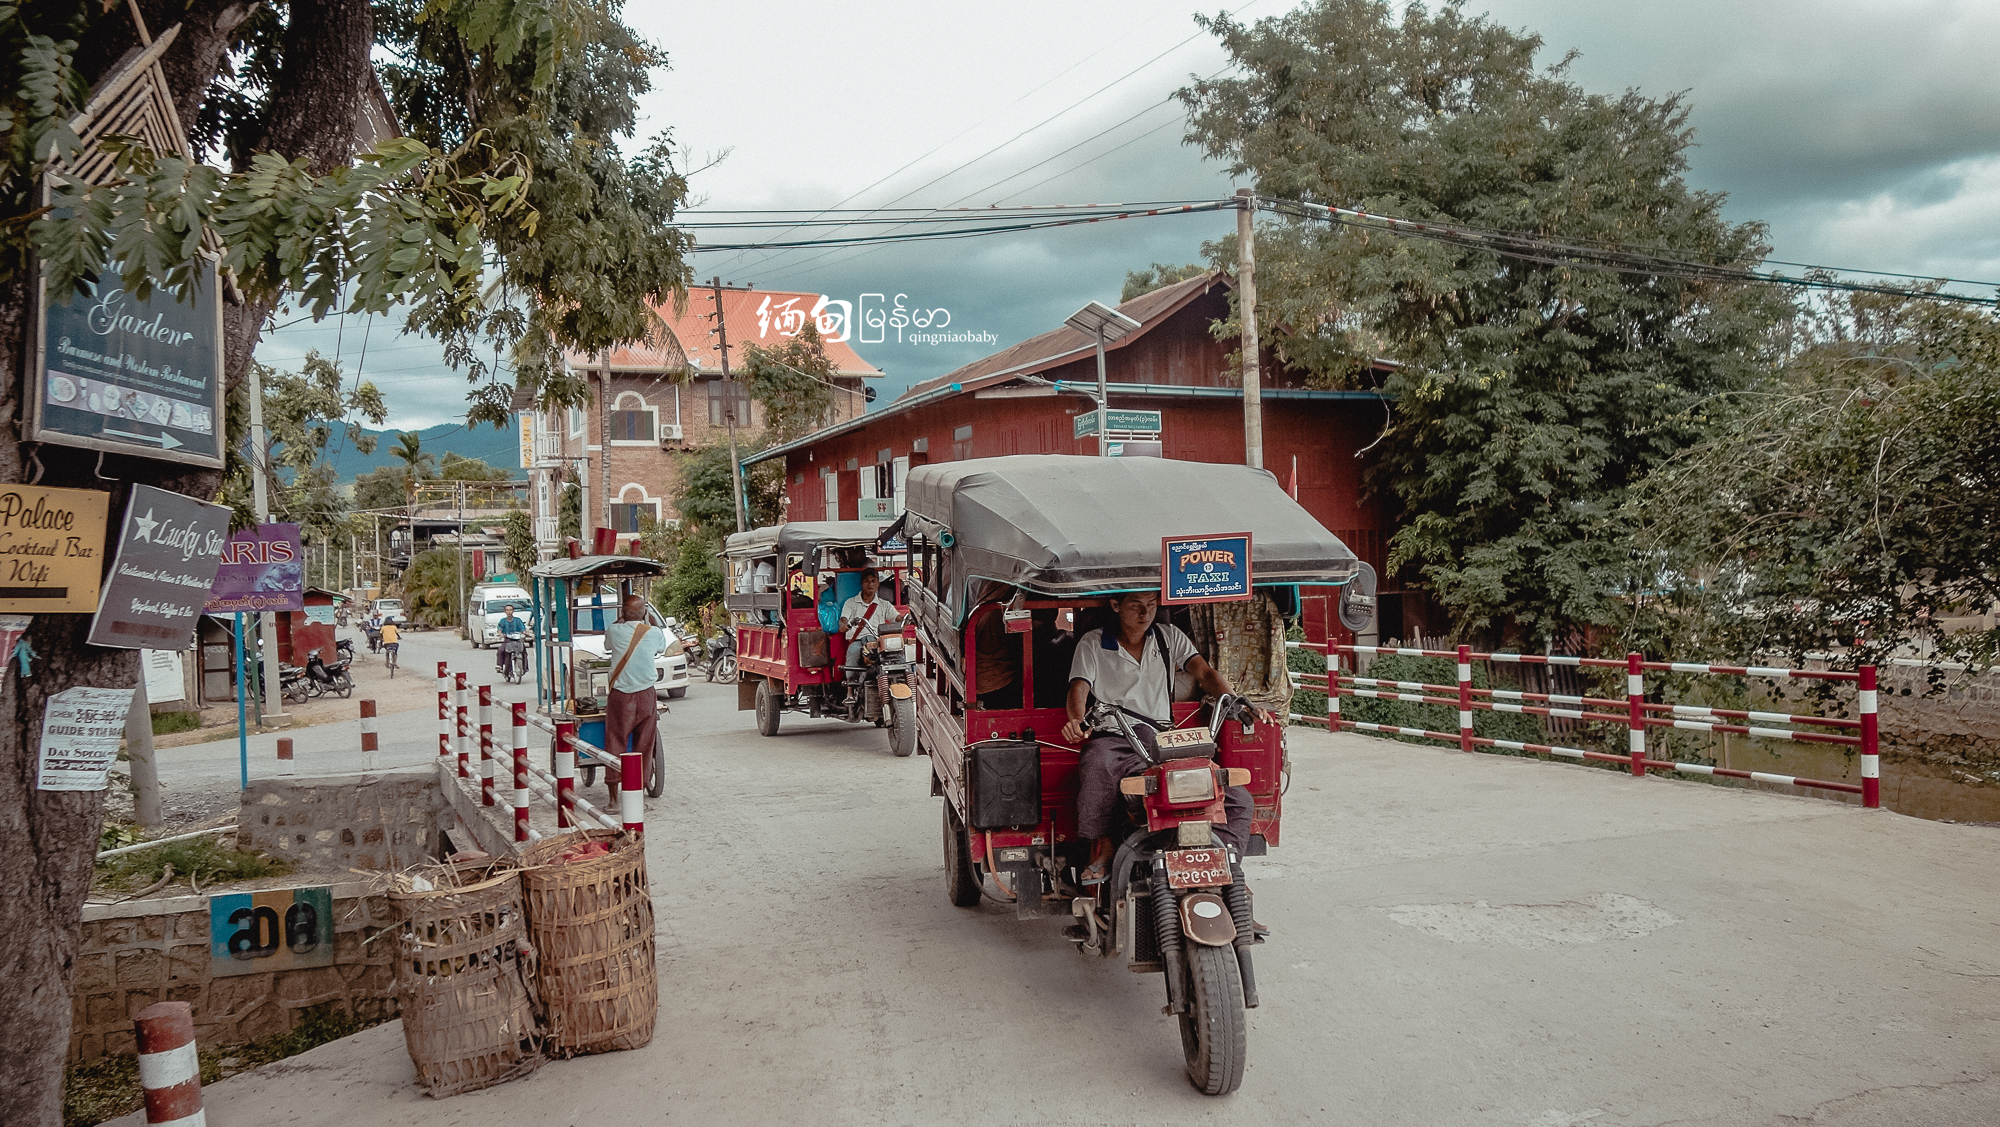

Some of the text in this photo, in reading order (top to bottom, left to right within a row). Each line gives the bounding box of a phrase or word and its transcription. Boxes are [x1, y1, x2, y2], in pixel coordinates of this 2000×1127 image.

[86, 284, 193, 348] Garden
[0, 492, 74, 531] Palace
[0, 532, 94, 558] Cocktail Bar
[152, 518, 201, 562] Lucky
[9, 559, 50, 588] Wifi
[1179, 550, 1237, 573] POWER
[1186, 571, 1230, 584] TAXI
[48, 725, 85, 736] GUIDE
[1162, 731, 1204, 746] TAXI
